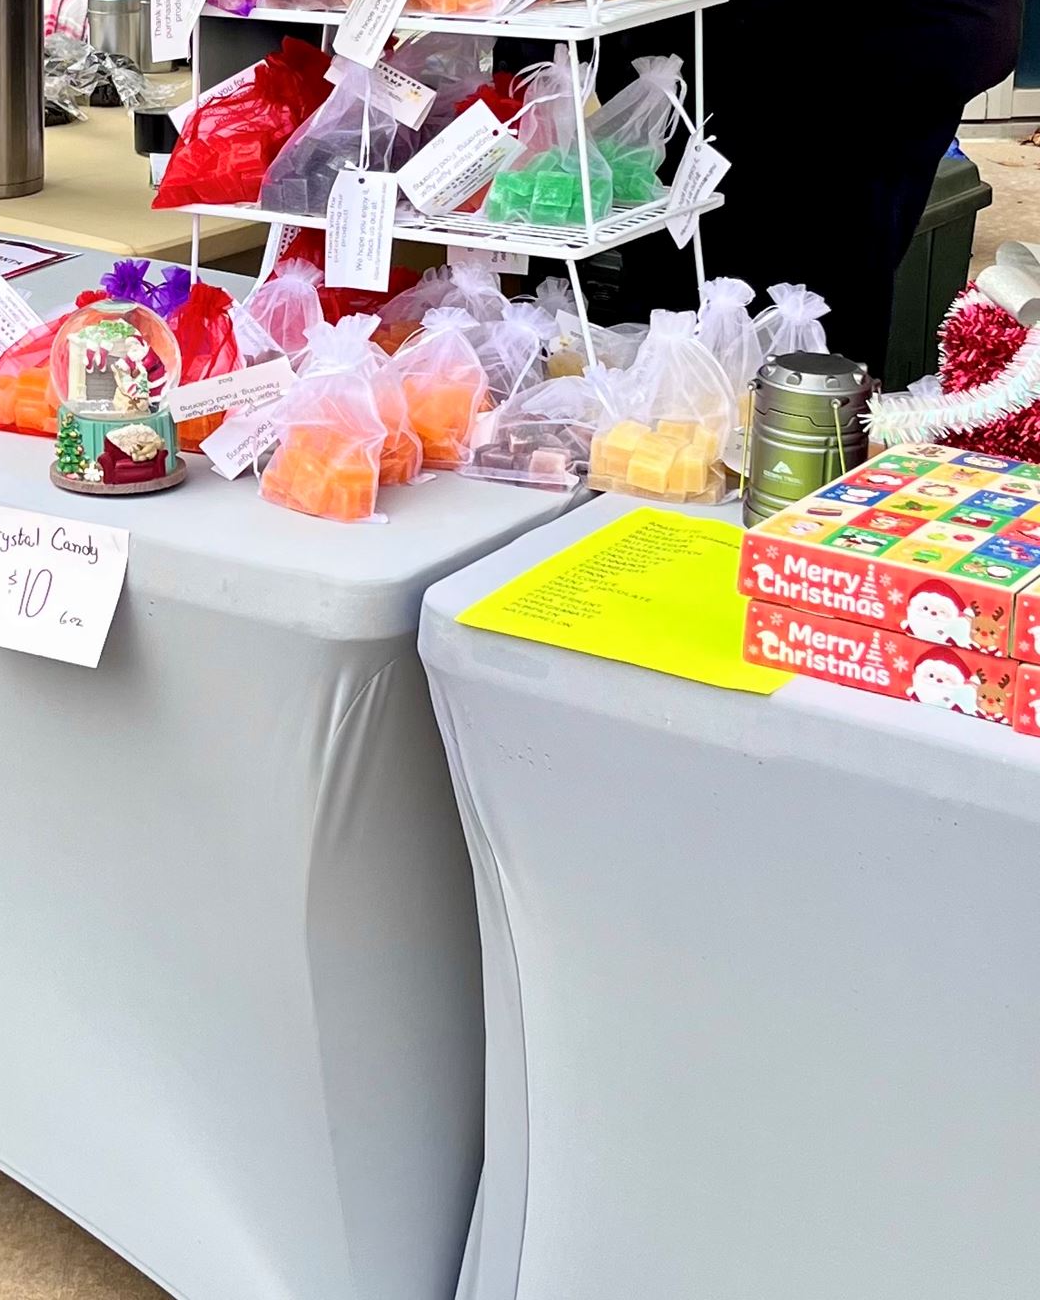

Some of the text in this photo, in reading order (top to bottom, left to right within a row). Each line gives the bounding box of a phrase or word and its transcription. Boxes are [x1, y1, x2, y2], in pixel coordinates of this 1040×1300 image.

[360, 197, 369, 218] enjoy
[359, 220, 367, 235] you
[369, 226, 375, 236] us
[356, 236, 366, 256] hope
[367, 238, 375, 261] check
[355, 258, 362, 271] We
[179, 397, 215, 414] Coloring
[216, 392, 237, 403] Food
[51, 527, 99, 565] Candy
[784, 554, 860, 595] Merry
[8, 568, 53, 618] $10
[756, 569, 886, 620] Christmas
[788, 621, 865, 662] Merry
[760, 636, 891, 687] Christmas
